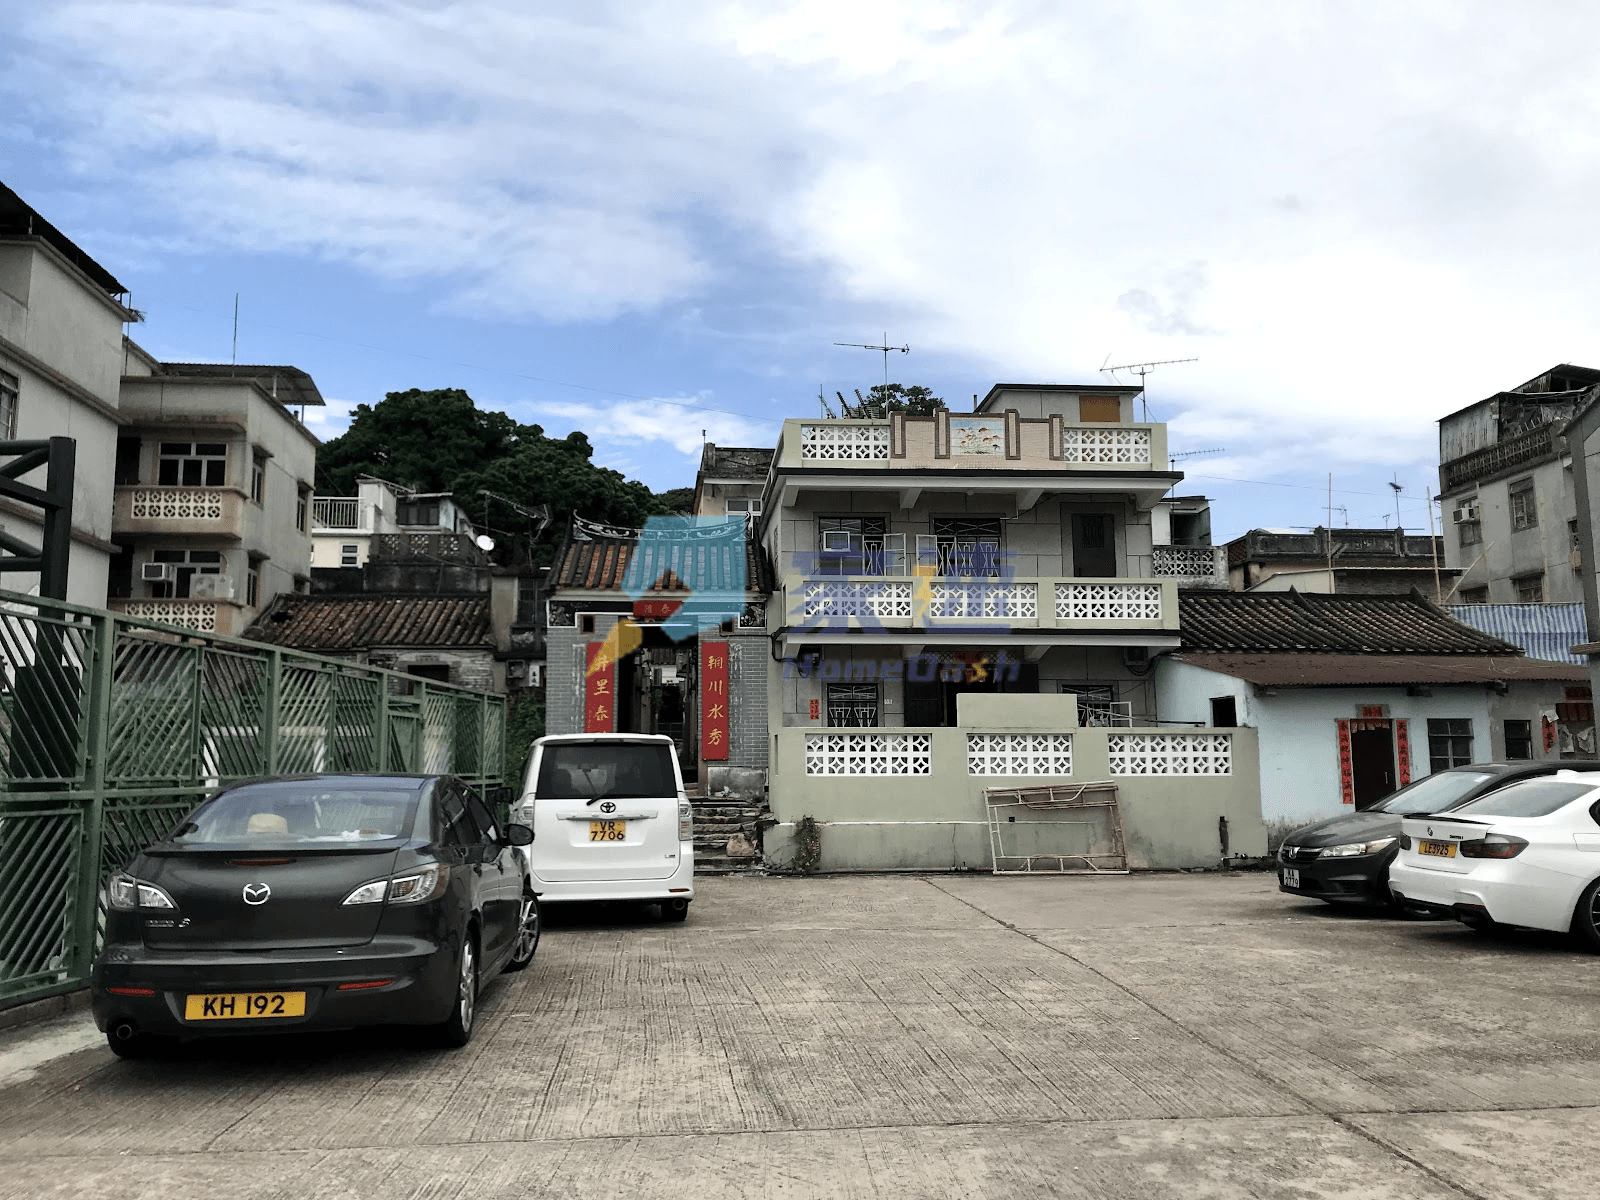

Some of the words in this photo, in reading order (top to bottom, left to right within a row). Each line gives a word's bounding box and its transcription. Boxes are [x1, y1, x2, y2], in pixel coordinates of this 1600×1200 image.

[599, 821, 615, 831] VR
[591, 831, 625, 841] 7706
[1424, 842, 1449, 855] LE3925
[203, 997, 235, 1016] KH
[246, 995, 285, 1015] 192
